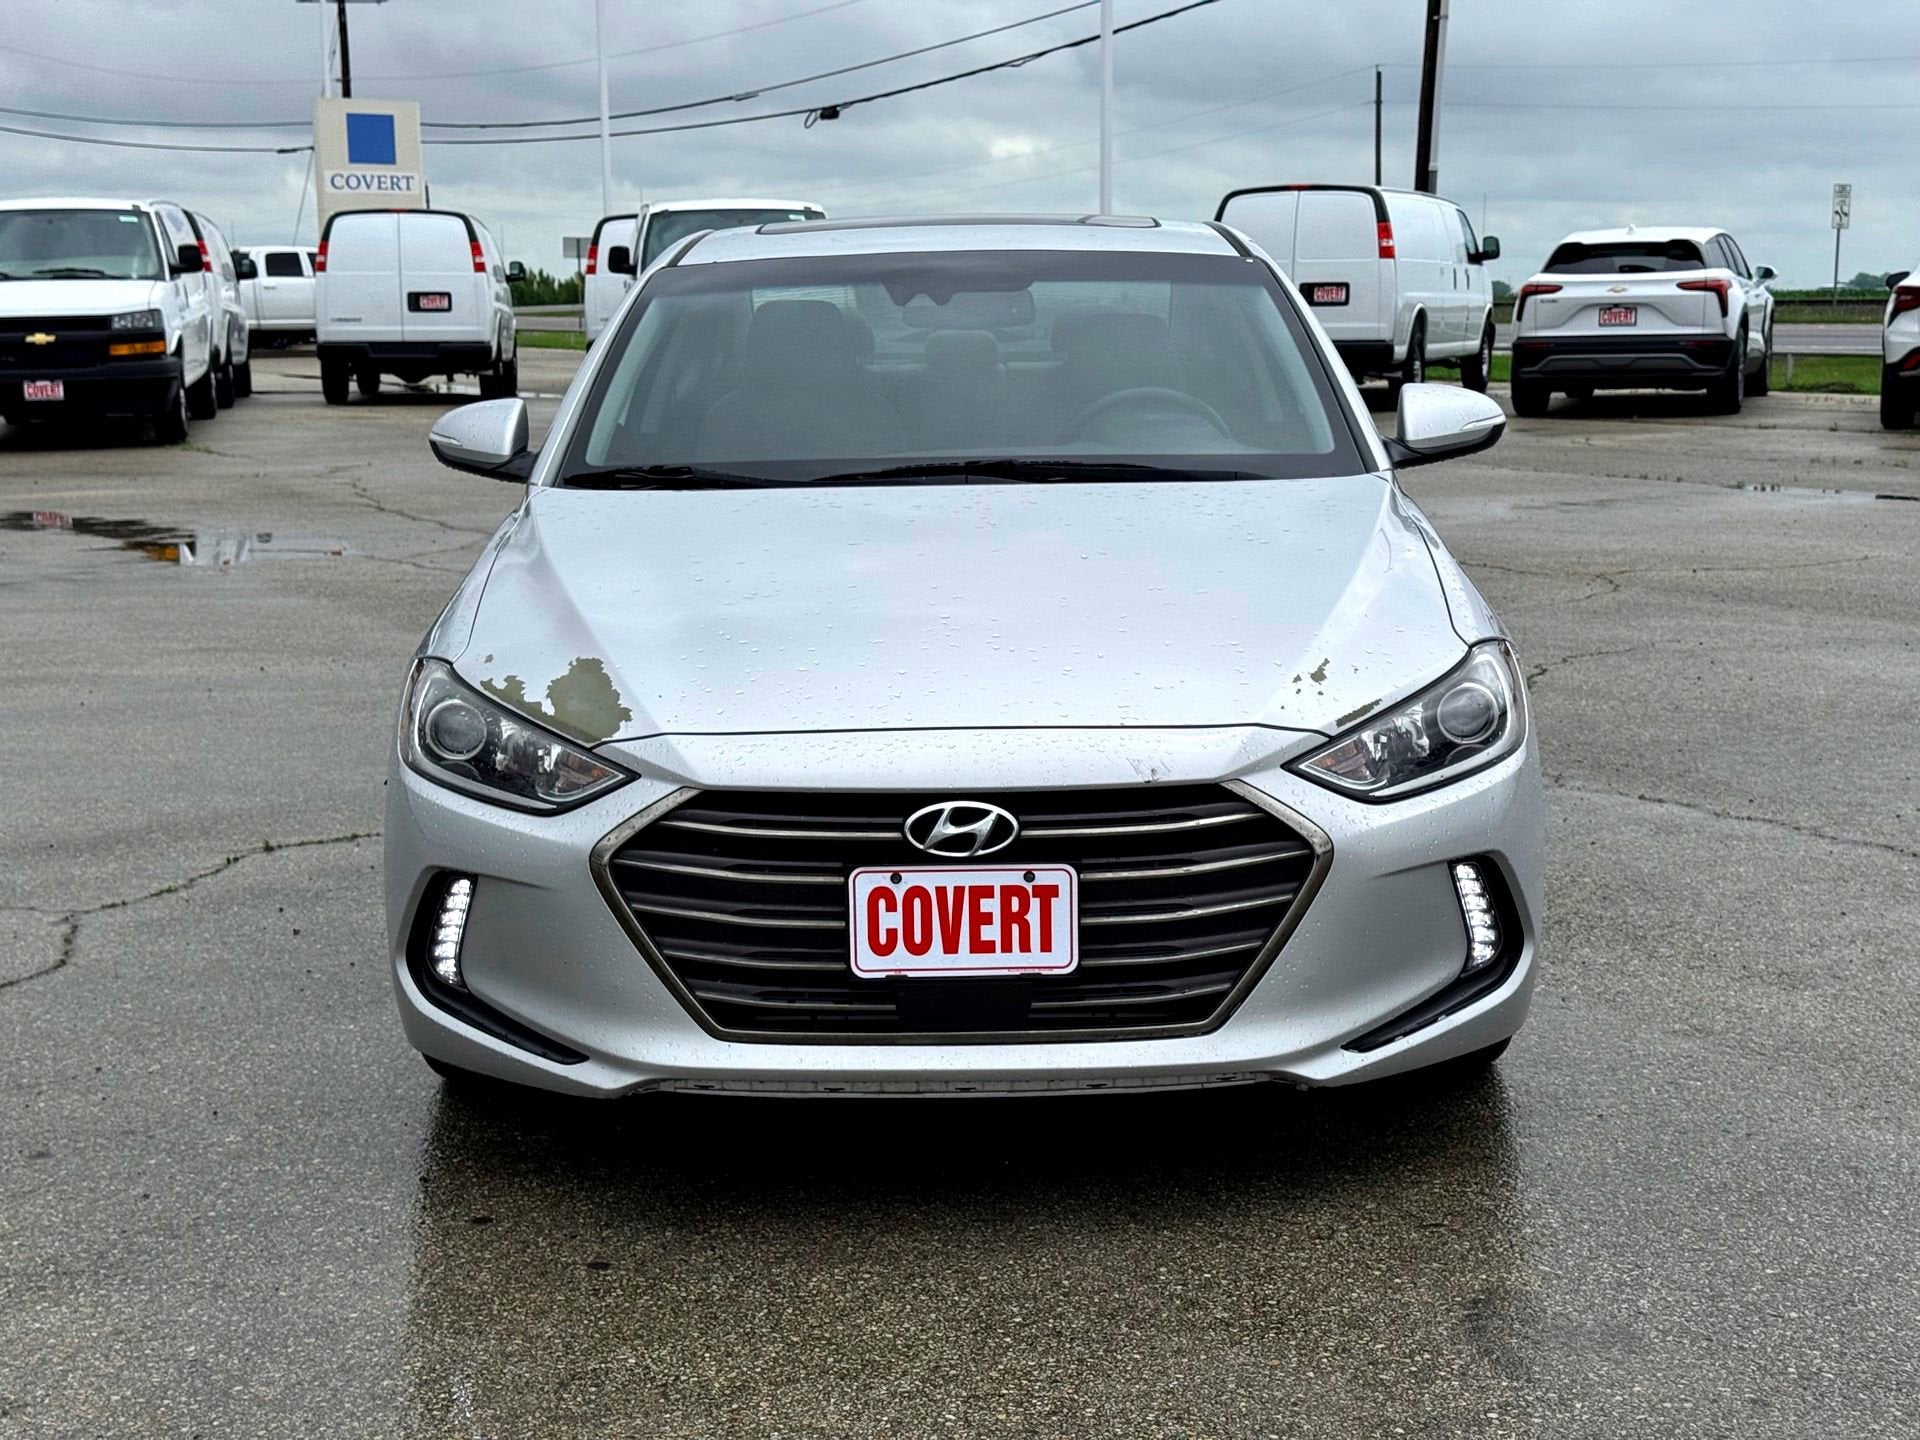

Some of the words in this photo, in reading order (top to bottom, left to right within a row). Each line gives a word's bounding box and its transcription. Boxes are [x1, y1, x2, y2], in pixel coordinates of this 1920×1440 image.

[330, 173, 415, 191] COVERT
[1601, 310, 1633, 325] COVERT
[26, 382, 61, 398] COVERT
[866, 884, 1060, 957] COVERT
